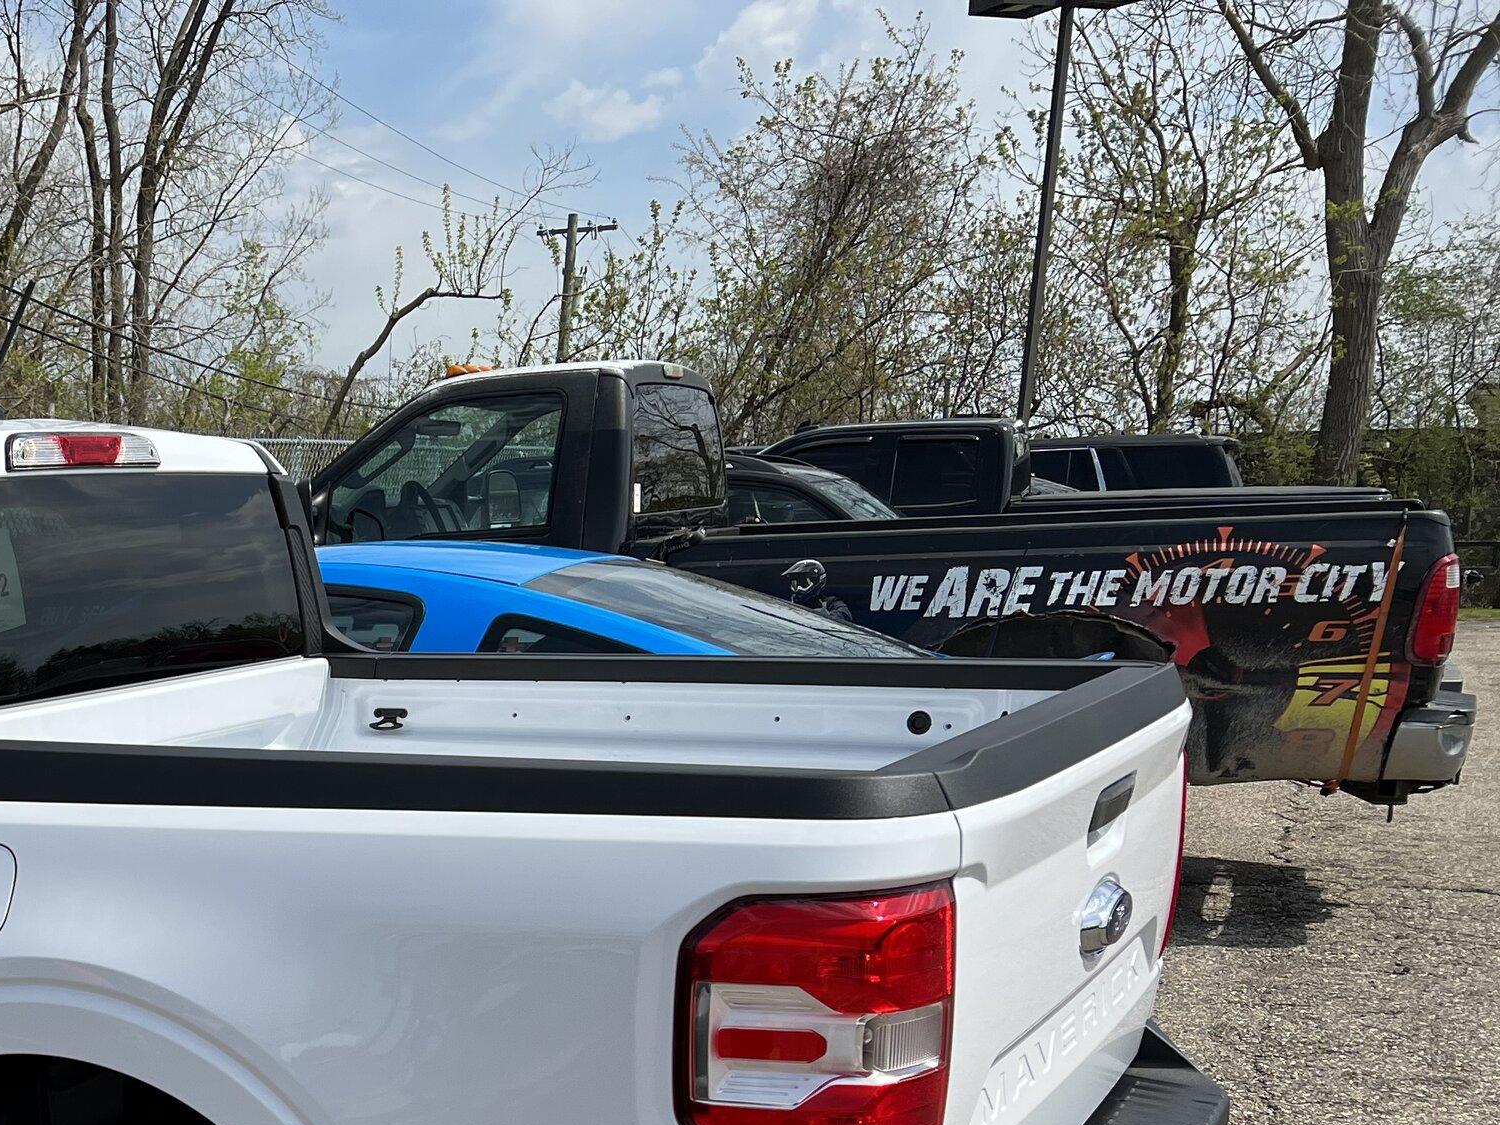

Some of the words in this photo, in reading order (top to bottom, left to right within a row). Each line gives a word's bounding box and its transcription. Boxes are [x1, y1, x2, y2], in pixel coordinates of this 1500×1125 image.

[869, 574, 929, 611] WE
[923, 565, 1044, 618] ARE
[1046, 569, 1128, 607] THE
[1129, 564, 1288, 608] MOTOR
[1294, 561, 1406, 603] CITY
[1307, 620, 1351, 642] 6
[1307, 679, 1359, 707] 7
